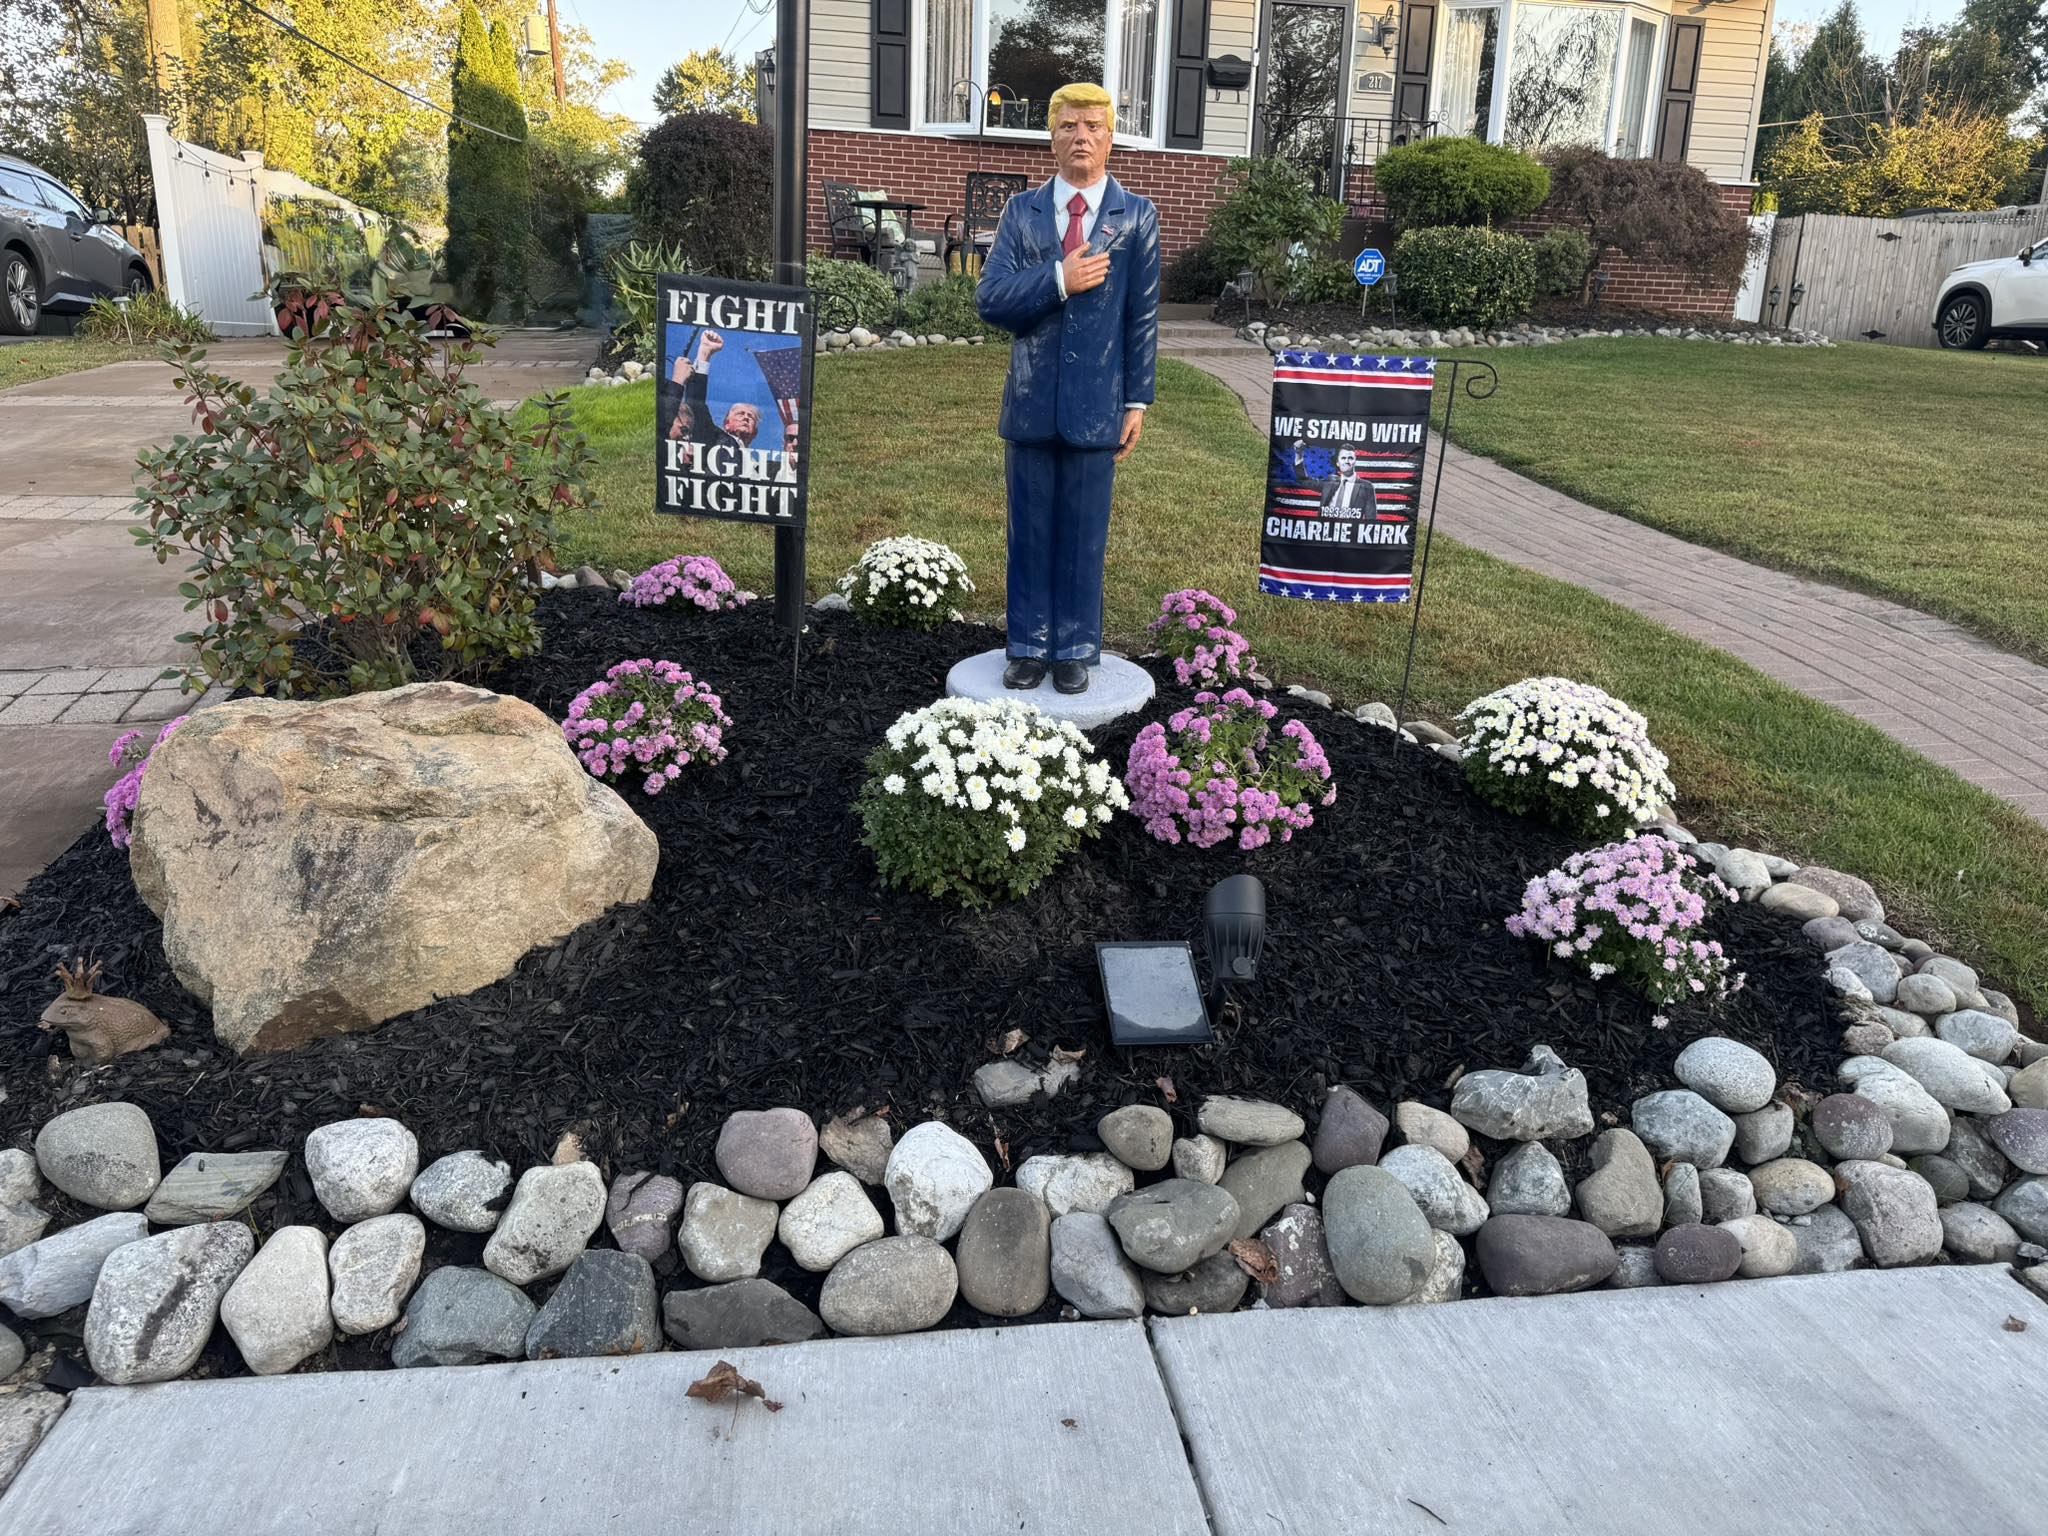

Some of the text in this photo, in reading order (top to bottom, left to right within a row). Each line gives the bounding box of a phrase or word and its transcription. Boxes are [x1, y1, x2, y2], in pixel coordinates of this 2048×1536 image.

[1368, 75, 1383, 89] 217
[1357, 259, 1382, 273] ADT
[666, 289, 804, 334] FIGHT
[1274, 416, 1422, 444] WE STAND WITH
[664, 439, 798, 484] FIGHT
[665, 475, 798, 517] FIGHT
[1266, 516, 1410, 545] CHARLIE KIRK
